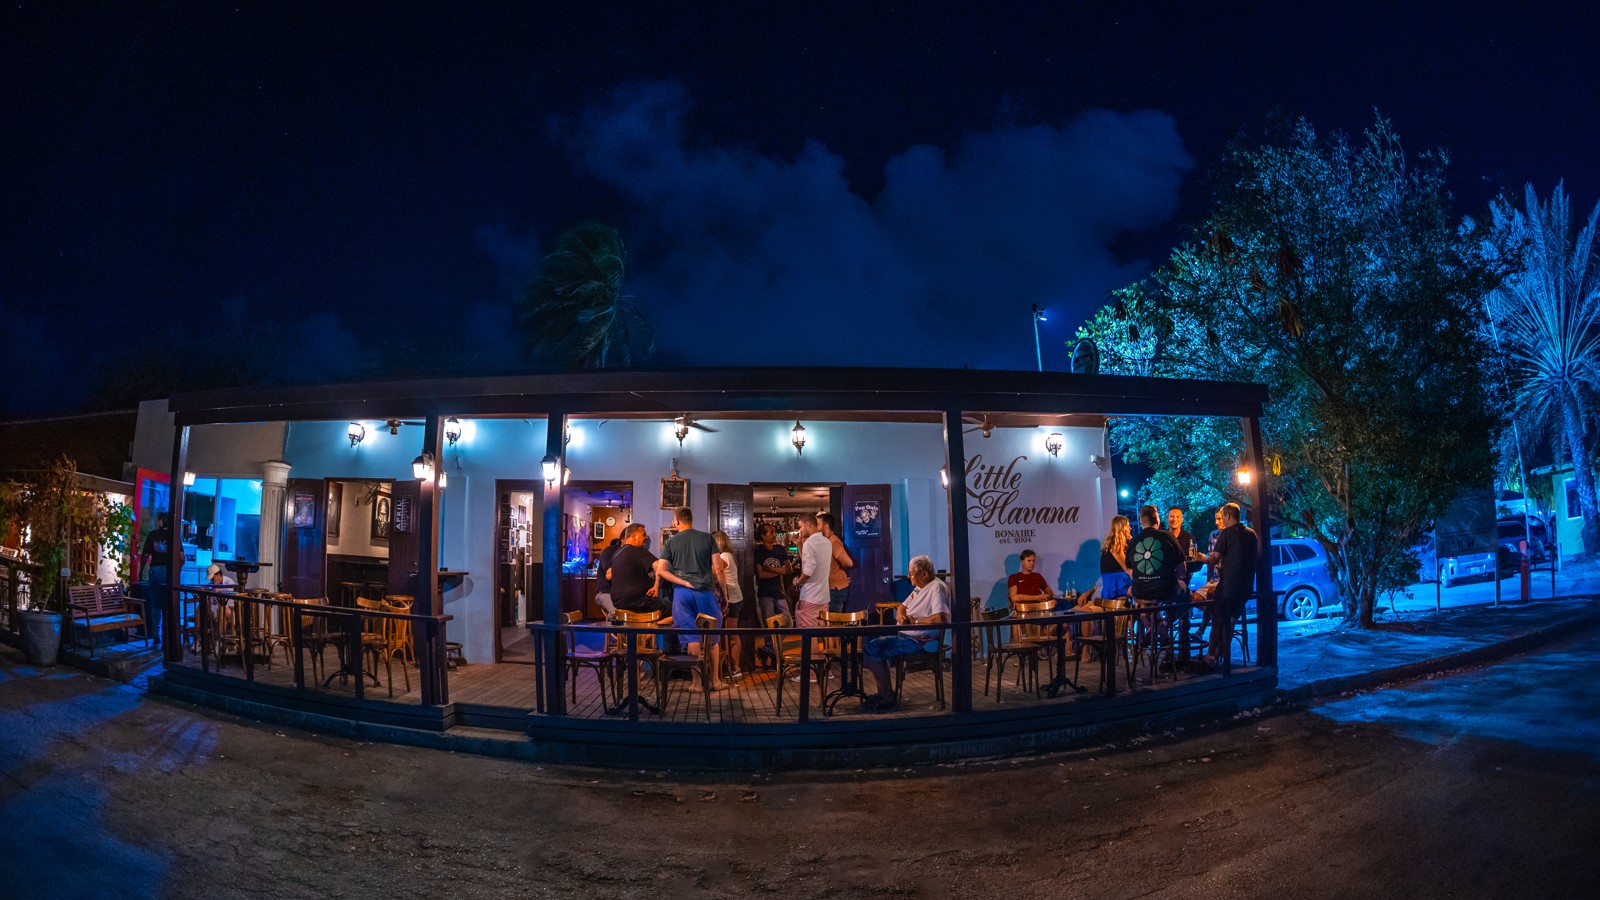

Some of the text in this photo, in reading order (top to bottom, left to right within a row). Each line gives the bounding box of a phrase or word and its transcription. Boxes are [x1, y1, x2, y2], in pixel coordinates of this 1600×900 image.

[964, 454, 1027, 498] Little
[967, 490, 1080, 528] Havana
[995, 529, 1036, 538] BONAIRE
